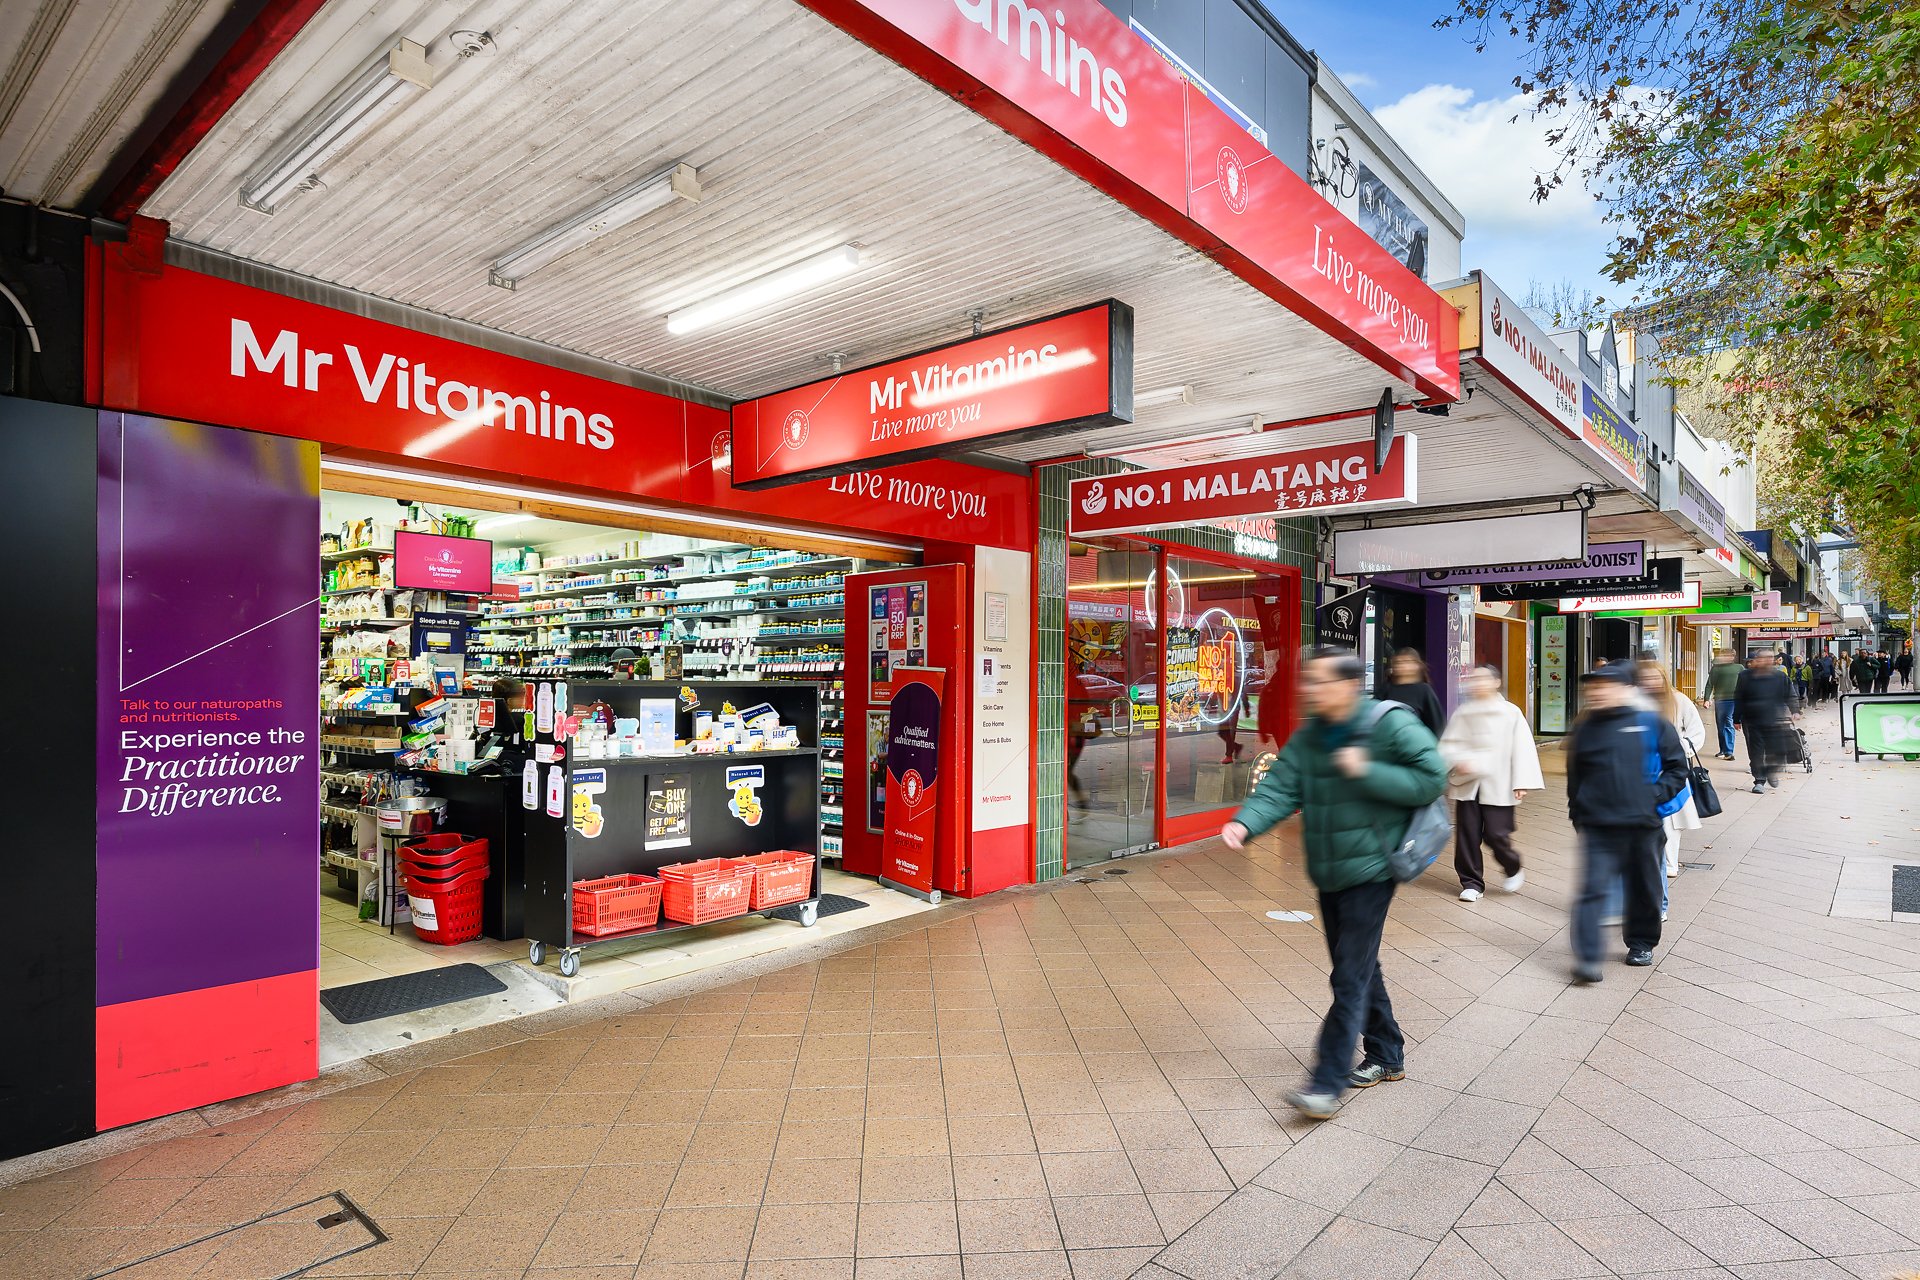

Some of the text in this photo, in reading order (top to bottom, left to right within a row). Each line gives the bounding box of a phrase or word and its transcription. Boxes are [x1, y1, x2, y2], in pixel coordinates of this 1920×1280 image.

[1378, 199, 1393, 226] MY
[1312, 224, 1429, 350] Live more you
[1504, 317, 1577, 405] NO.1 MALATANG
[230, 318, 615, 450] Mr Vitamins
[870, 343, 1058, 414] Mr Vitamins
[869, 402, 982, 443] Live more you
[1114, 456, 1368, 511] NO.1 MALATANG
[887, 478, 945, 511] more
[948, 489, 988, 520] you
[1650, 566, 1660, 581] 1
[1590, 592, 1657, 604] Destination
[419, 616, 436, 625] Sleep
[891, 611, 905, 624] 50
[891, 623, 905, 632] OFF
[890, 631, 905, 640] RRP
[1320, 629, 1354, 642] MY HAIR
[983, 645, 1003, 653] Vitamins
[1166, 648, 1198, 665] COMING
[1199, 645, 1222, 668] NO
[1166, 660, 1198, 684] SOON
[1199, 680, 1225, 693] TANG
[119, 698, 283, 711] Talk to our naturopaths
[119, 711, 241, 723] and nutritionists.
[903, 725, 929, 739] Qualified
[121, 726, 305, 753] Experience the
[894, 735, 936, 750] advice matters.
[119, 751, 305, 782] Practitioner
[118, 782, 283, 817] Difference.
[666, 788, 687, 801] BUY
[982, 794, 1012, 804] Mr Vitamins
[666, 801, 686, 814] ONE
[649, 817, 677, 827] GET ONE
[649, 826, 666, 836] FREE
[894, 829, 906, 837] Online
